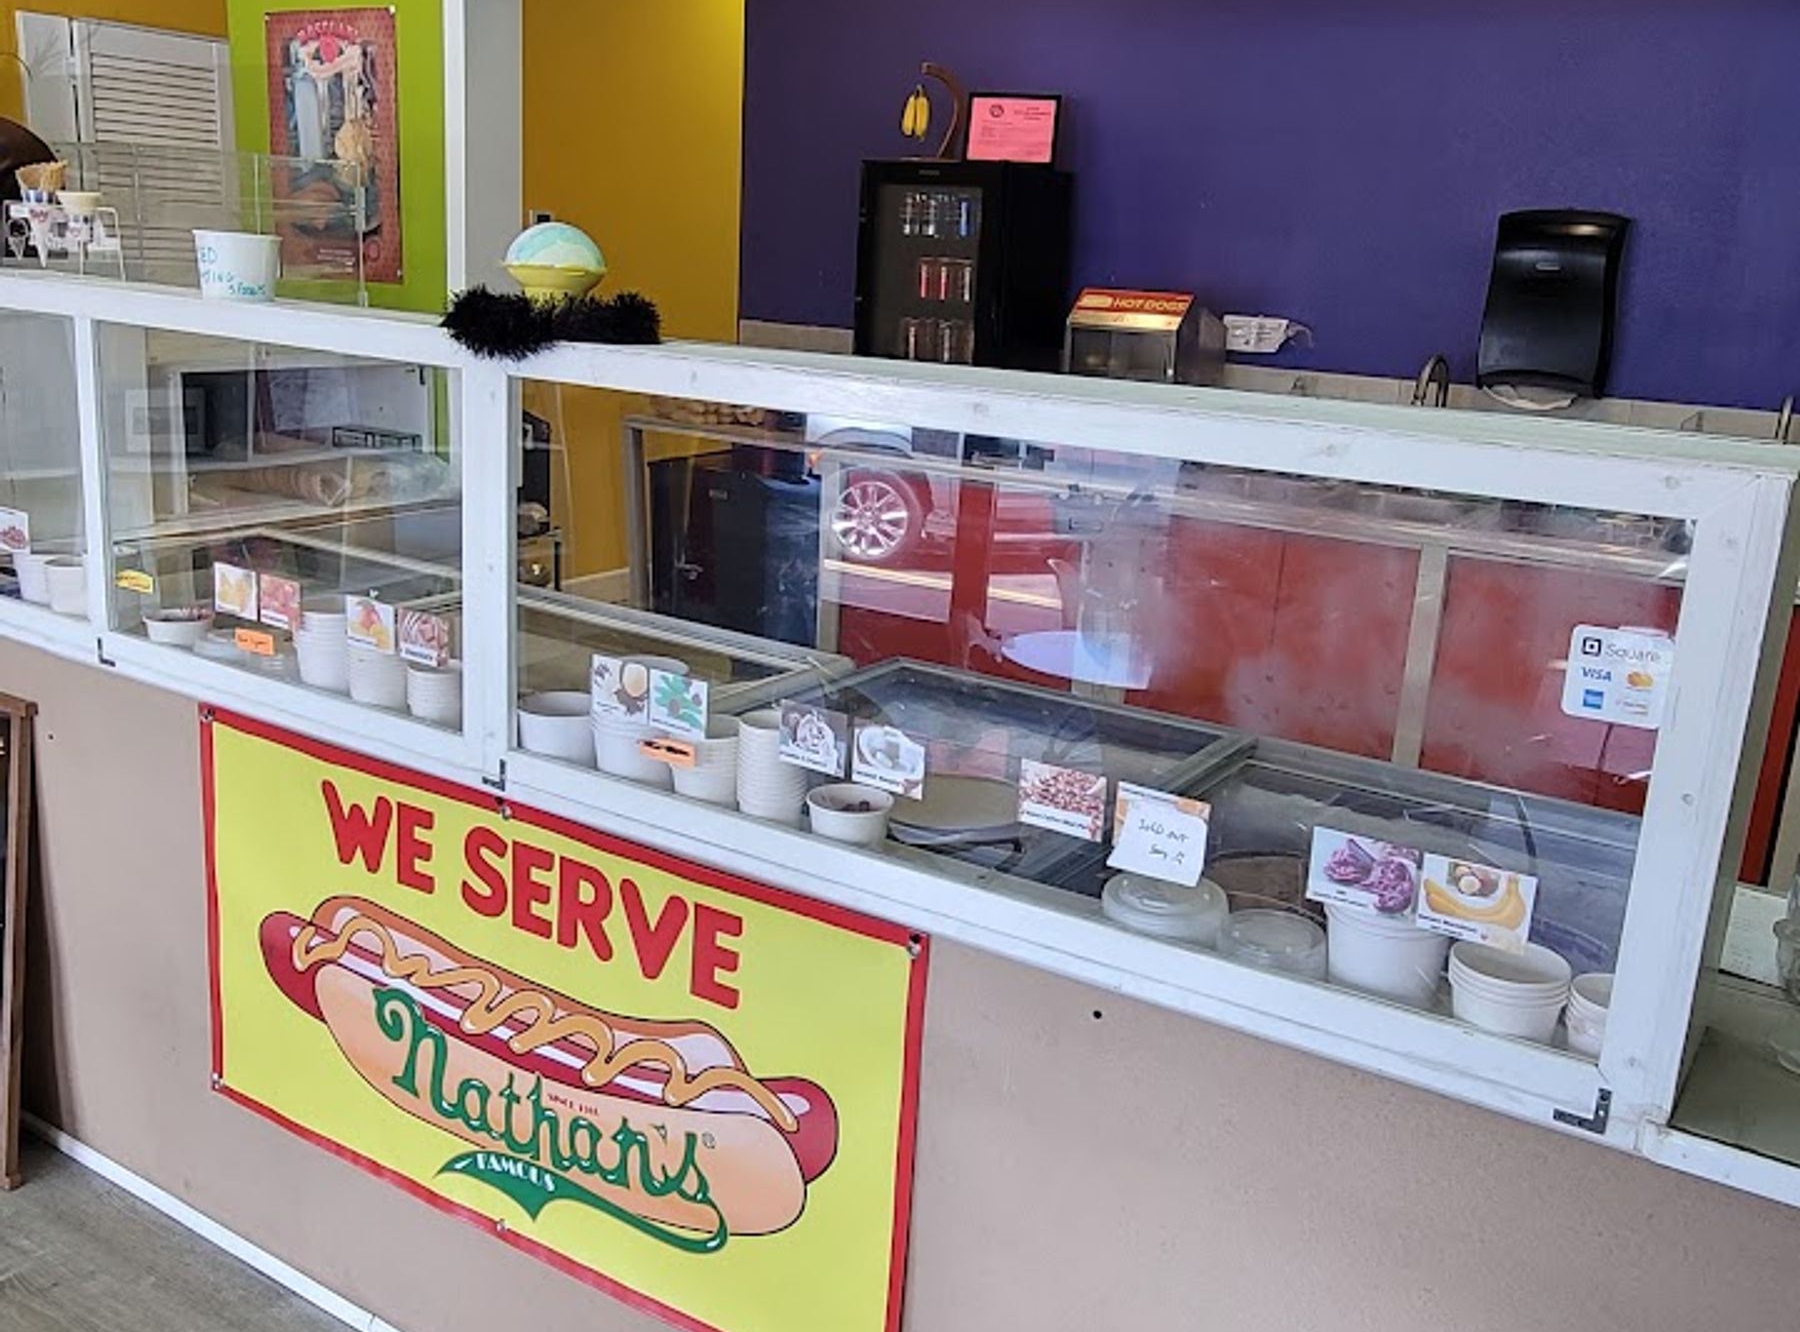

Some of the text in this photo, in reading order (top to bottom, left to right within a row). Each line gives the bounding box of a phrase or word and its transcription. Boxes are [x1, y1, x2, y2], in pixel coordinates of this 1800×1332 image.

[1581, 666, 1612, 682] VISA
[321, 779, 435, 895] WE
[460, 824, 744, 1011] SERVE
[371, 988, 712, 1206] Nathan's
[477, 1152, 556, 1193] FAMOUS
